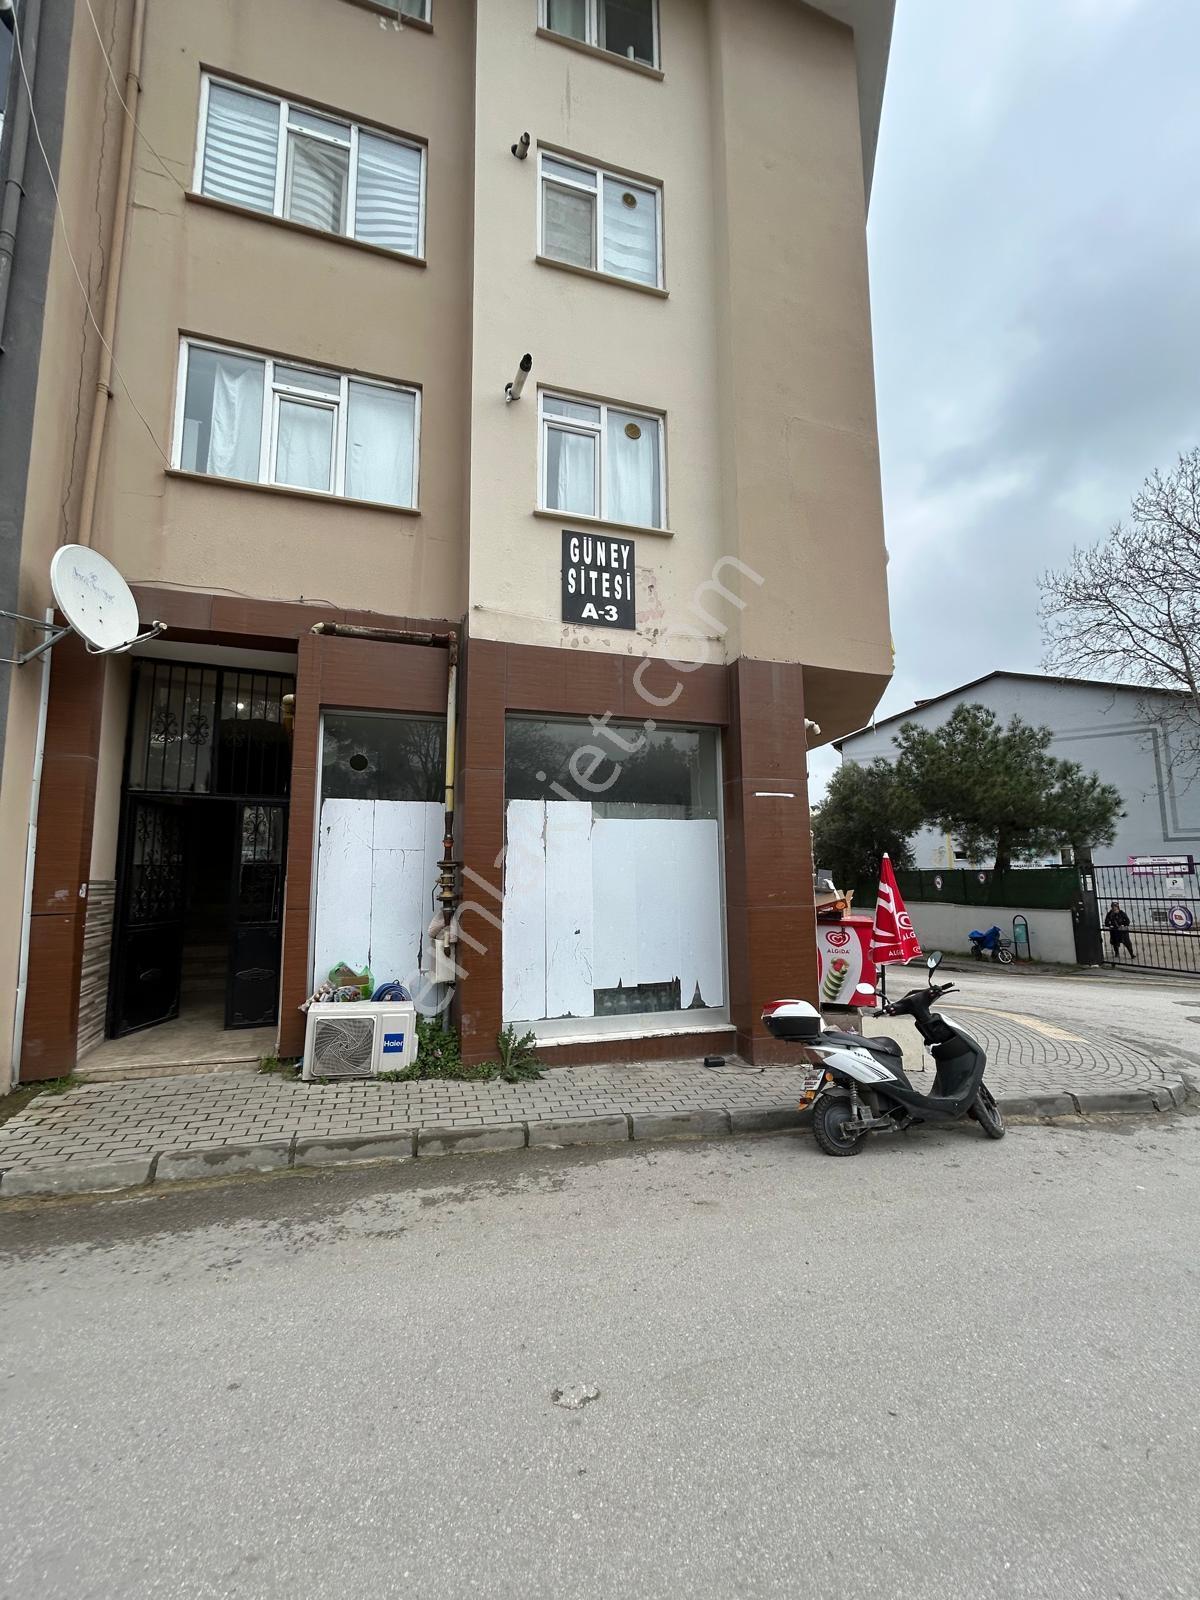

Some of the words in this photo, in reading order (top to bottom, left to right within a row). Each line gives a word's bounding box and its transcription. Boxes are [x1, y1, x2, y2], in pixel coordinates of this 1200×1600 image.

[570, 536, 630, 570] GÜNEY
[567, 566, 631, 601] SİTESİ
[581, 602, 619, 622] A-3
[384, 1039, 404, 1047] Haier
